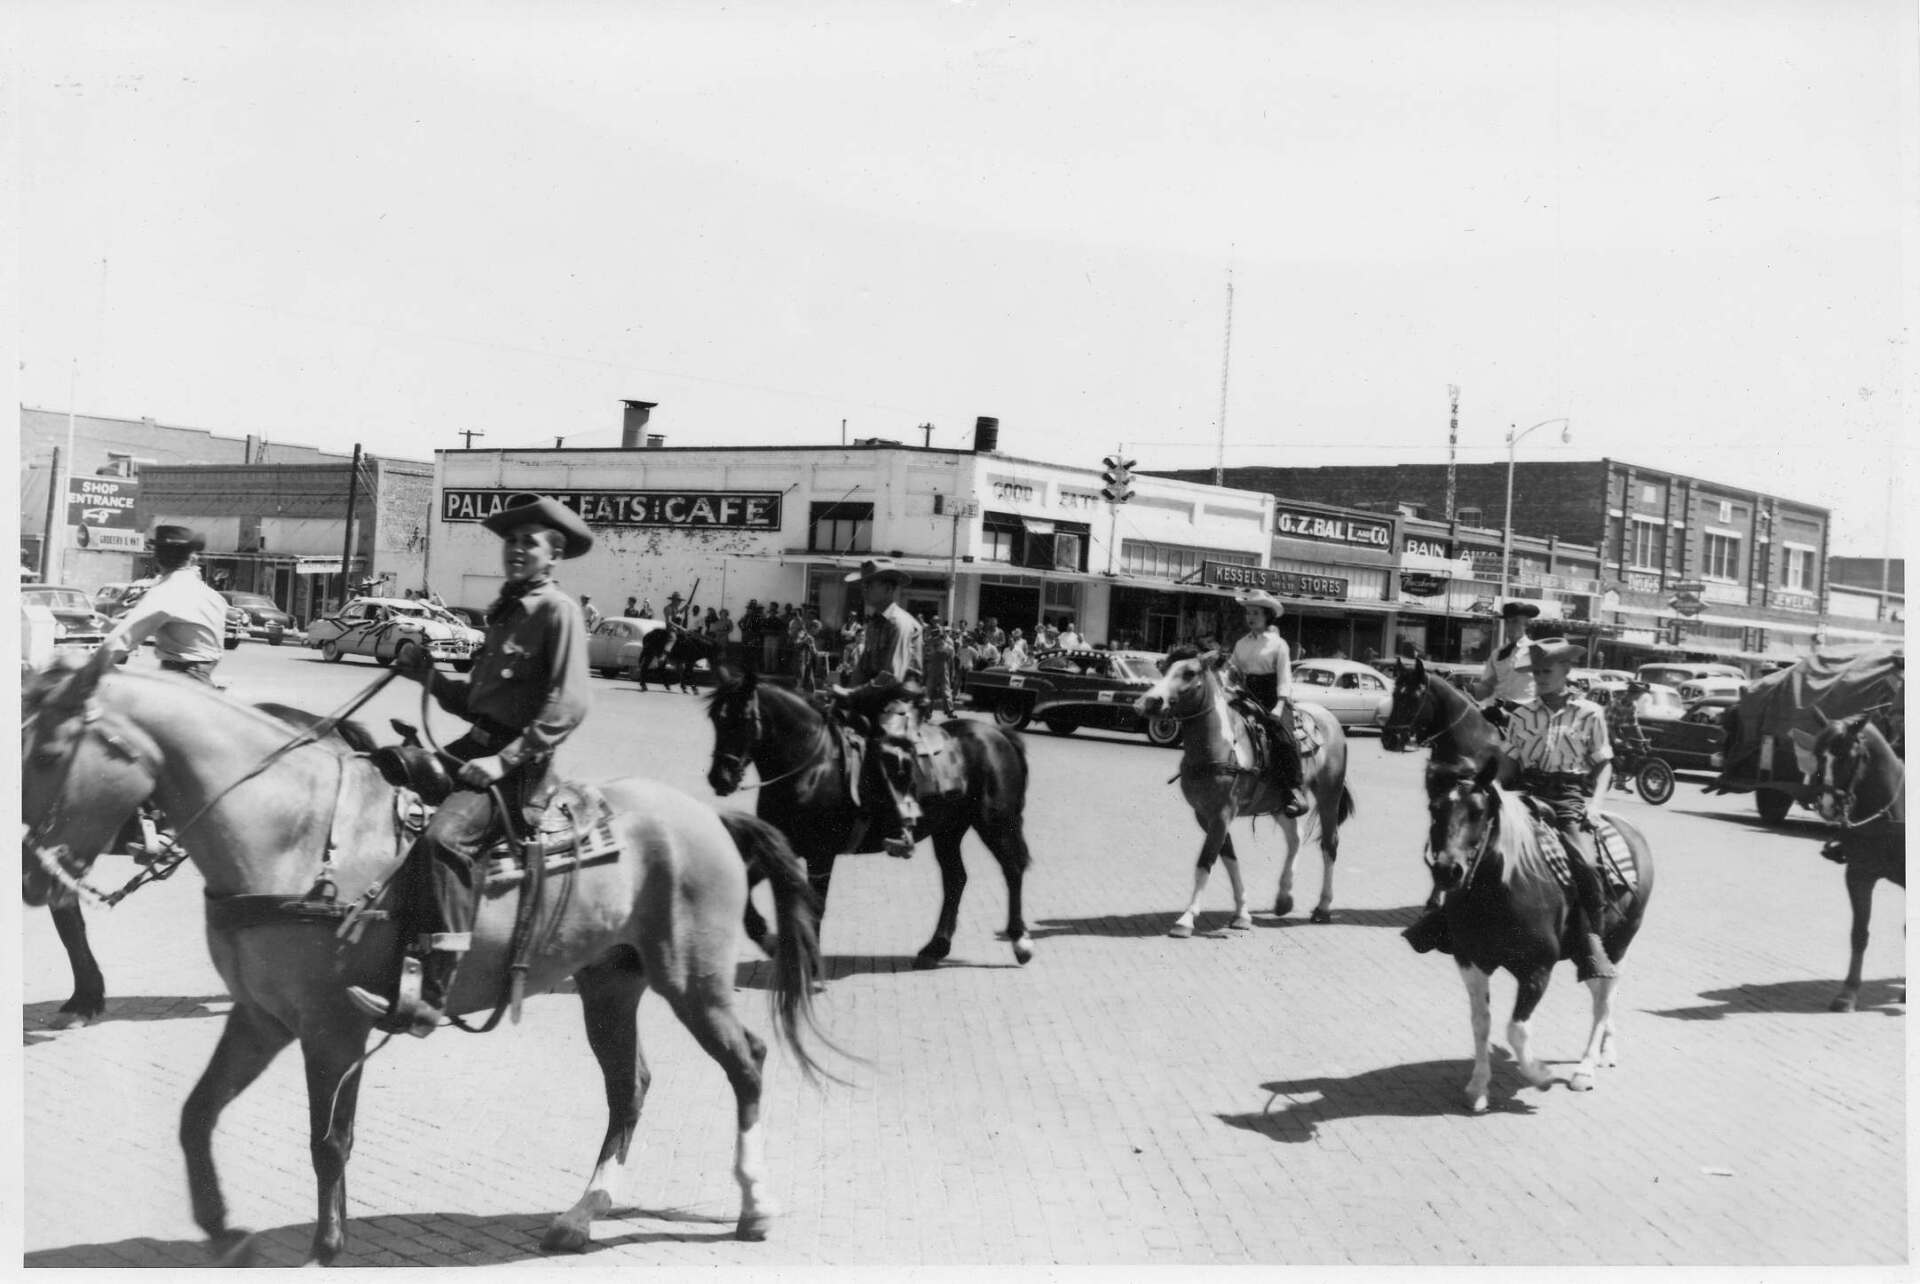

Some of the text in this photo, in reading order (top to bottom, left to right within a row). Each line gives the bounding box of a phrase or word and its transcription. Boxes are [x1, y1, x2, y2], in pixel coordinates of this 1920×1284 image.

[83, 481, 119, 494] SHOP
[68, 493, 134, 508] ENTRANCE
[579, 495, 647, 522] EATS
[664, 496, 770, 525] CAFE
[1407, 540, 1446, 558] BAIN
[1216, 566, 1266, 586] KESSEL'S
[1300, 577, 1341, 594] STORES
